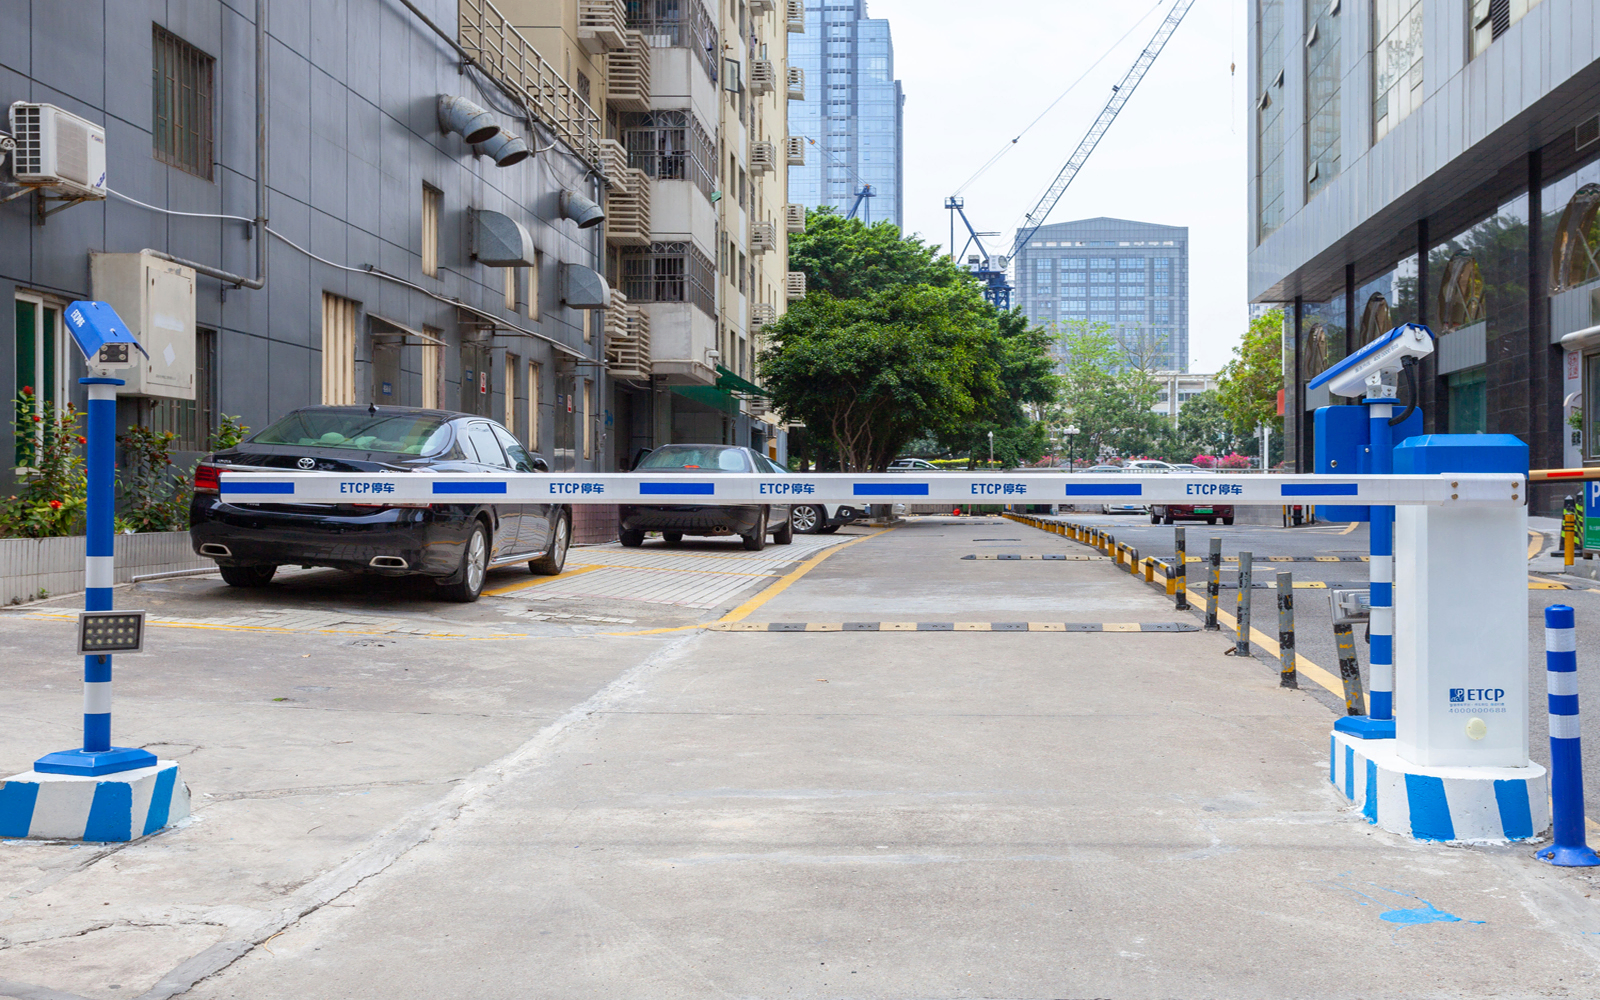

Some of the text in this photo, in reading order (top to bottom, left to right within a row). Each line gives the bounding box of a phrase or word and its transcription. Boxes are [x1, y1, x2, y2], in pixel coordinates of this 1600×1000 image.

[340, 482, 394, 493] ETCP停车
[550, 482, 604, 494] ETCP停车
[760, 482, 814, 494] ETCP停车
[971, 482, 1026, 494] ETCP停车
[1187, 483, 1242, 495] ETCP停车
[1467, 689, 1505, 701] ETCP
